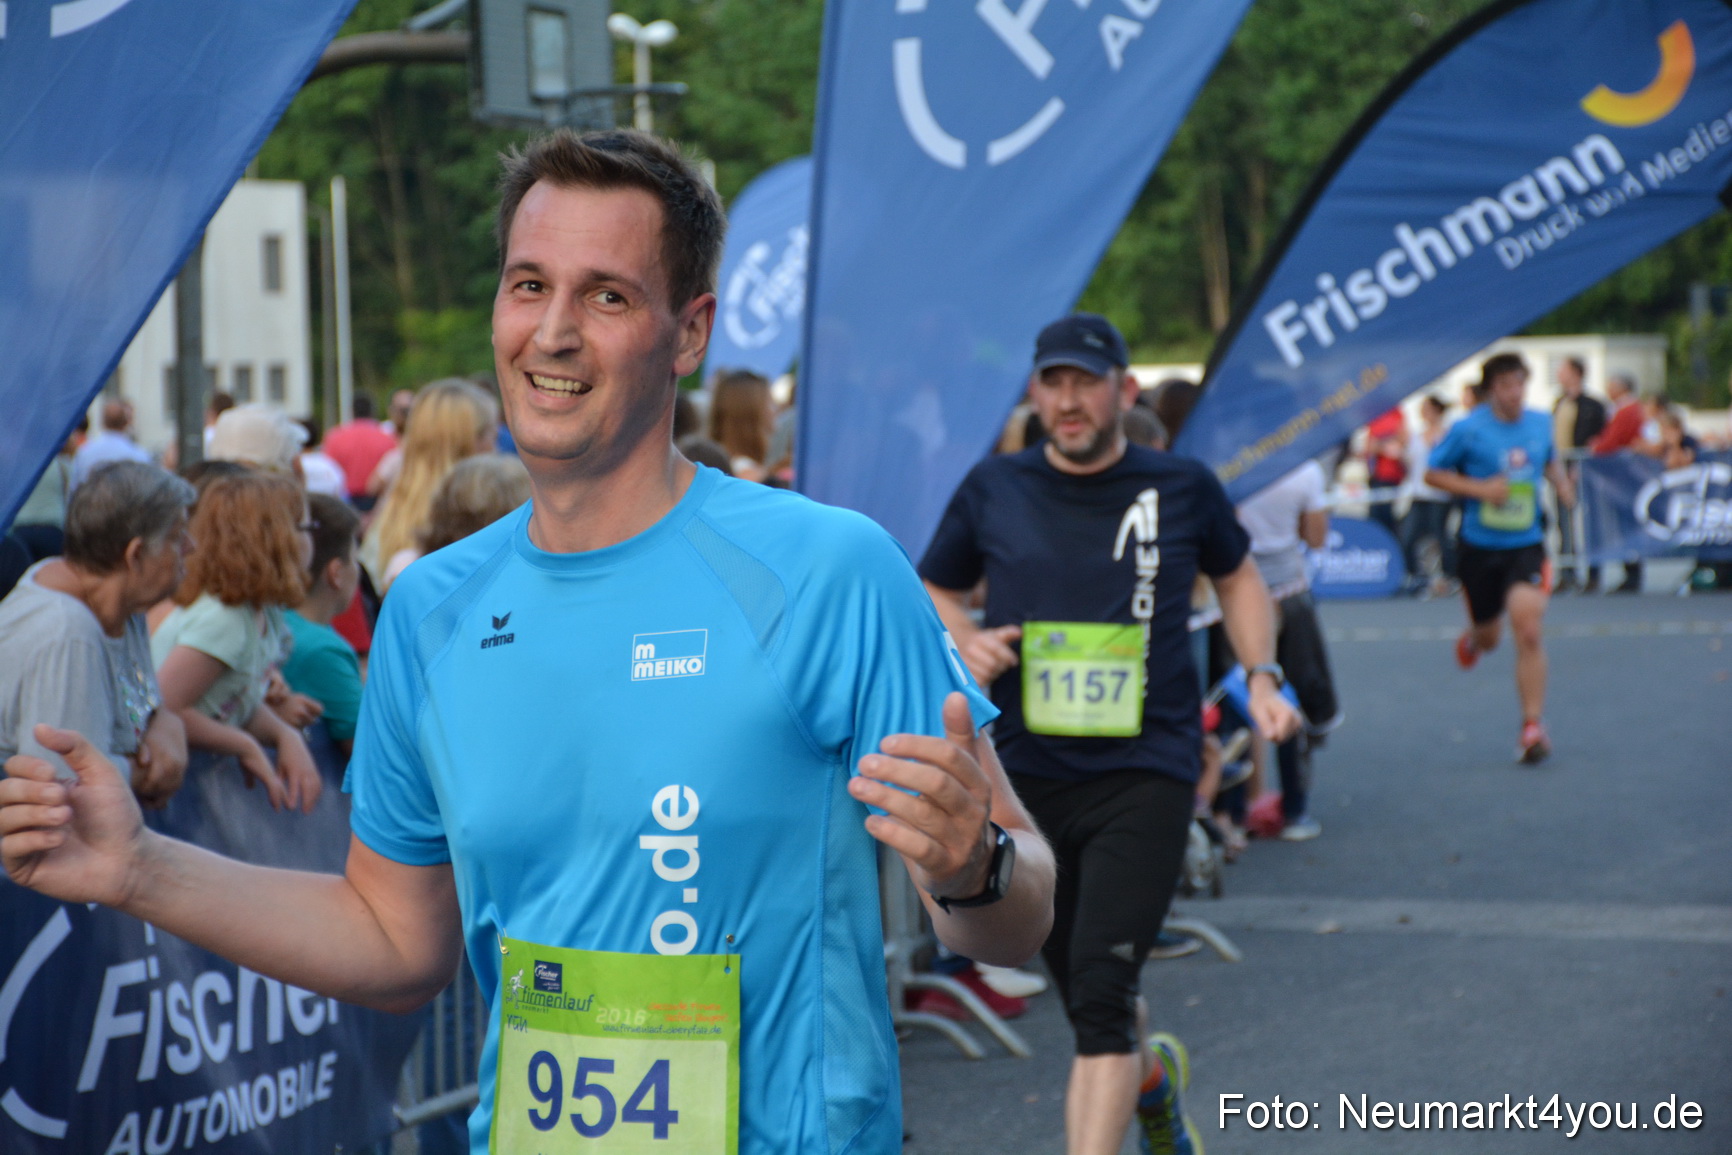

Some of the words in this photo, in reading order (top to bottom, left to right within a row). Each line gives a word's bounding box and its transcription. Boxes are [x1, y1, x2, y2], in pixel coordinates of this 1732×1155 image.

[1494, 202, 1586, 270] Druck
[1585, 170, 1646, 217] und
[1262, 133, 1627, 367] Frischmann
[480, 632, 515, 650] erima
[634, 657, 702, 679] MEIKO
[1036, 669, 1131, 703] 1157
[522, 985, 595, 1012] firmenlauf
[595, 1008, 648, 1026] 2016
[104, 1050, 338, 1155] AUTOMOBILE
[527, 1050, 679, 1140] 954
